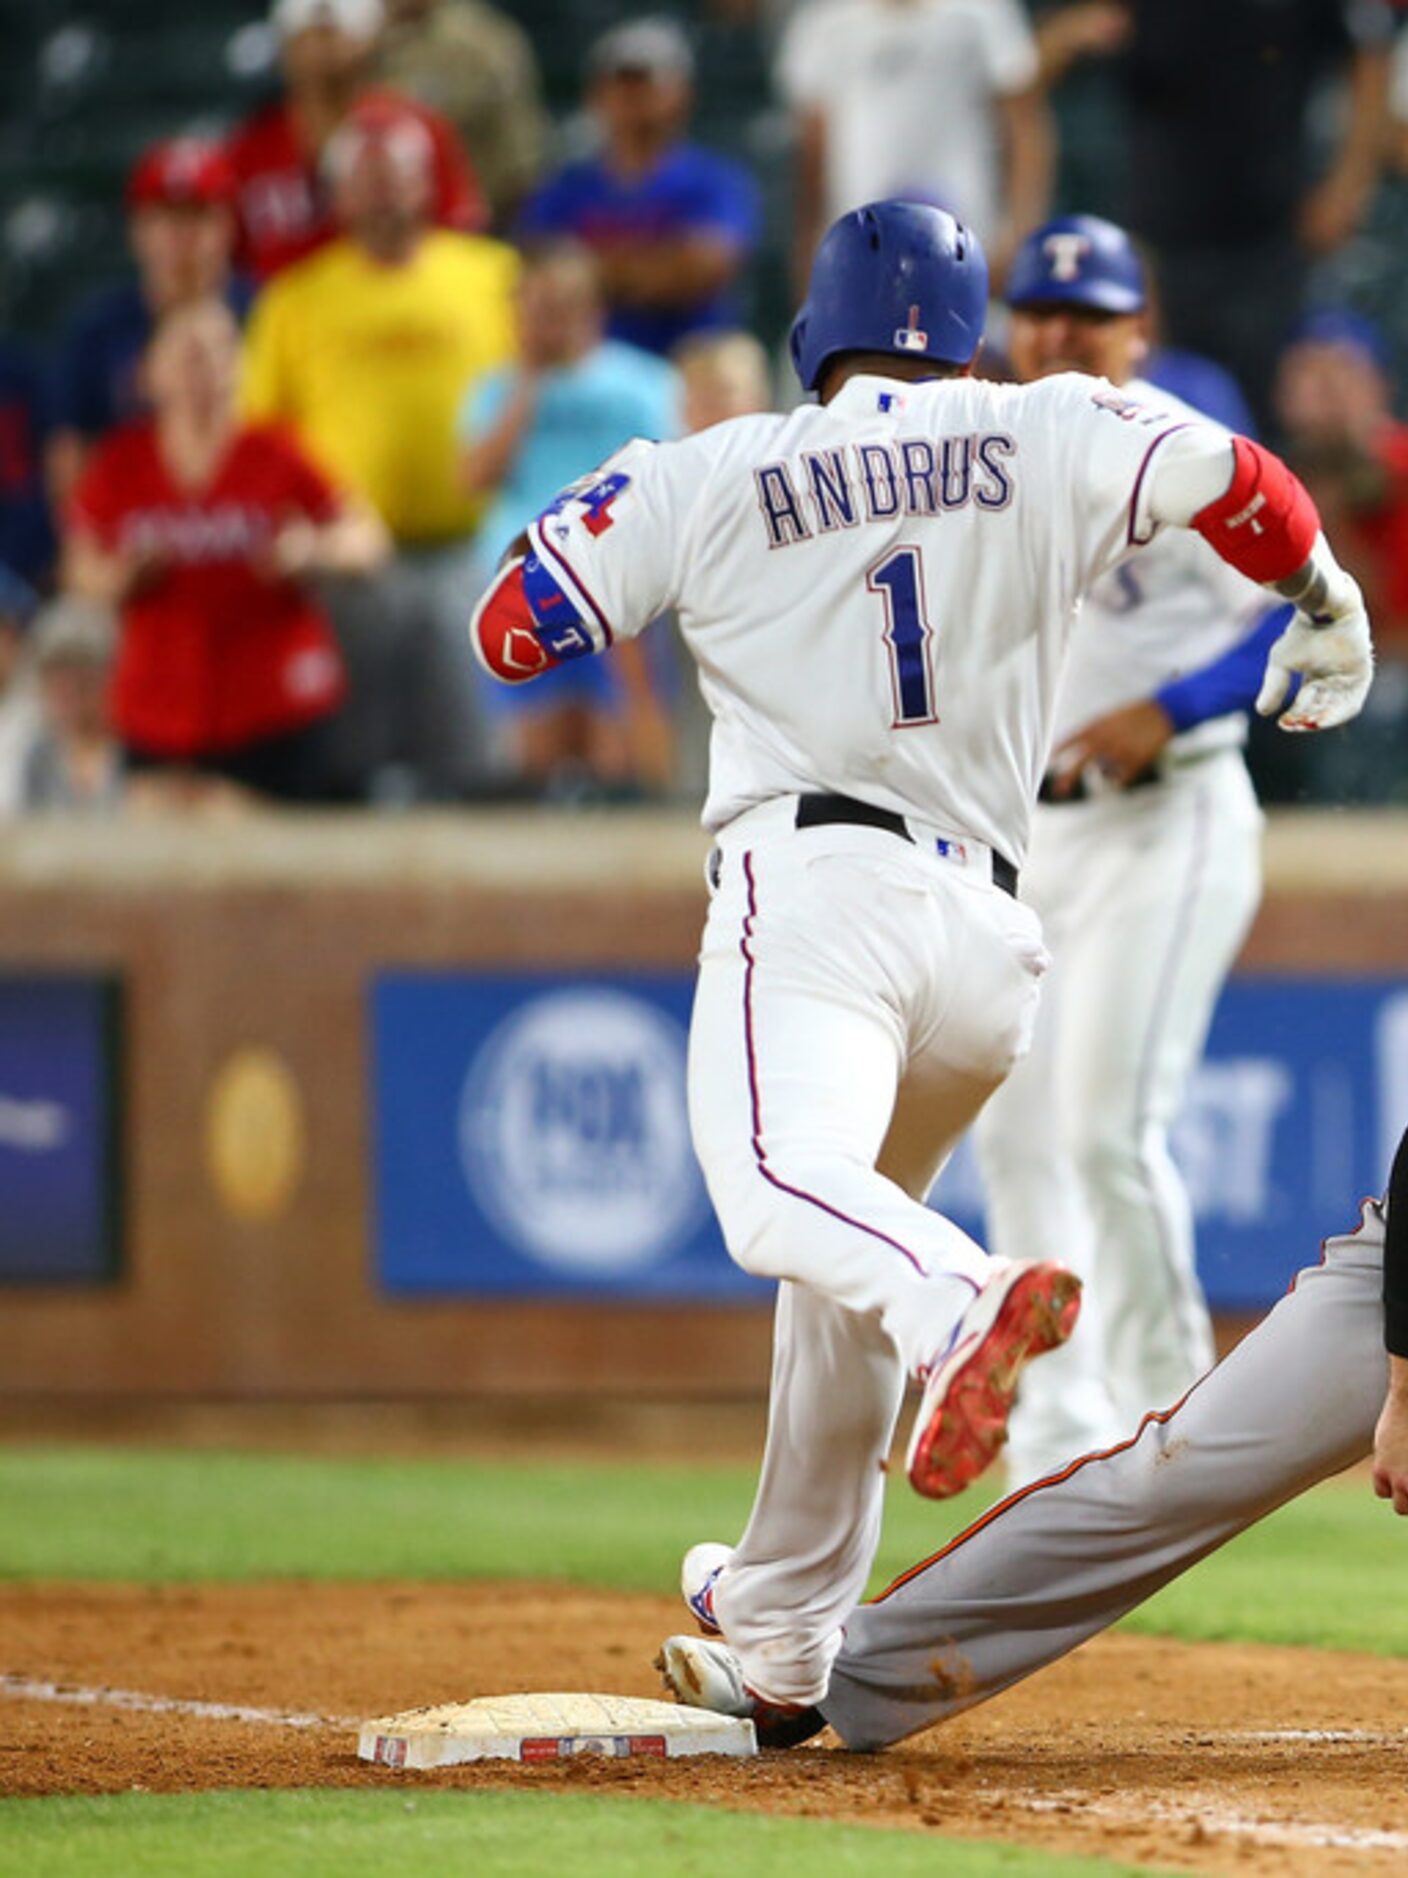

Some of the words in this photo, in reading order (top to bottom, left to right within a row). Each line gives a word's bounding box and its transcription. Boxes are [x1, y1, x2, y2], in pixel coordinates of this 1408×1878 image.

[1043, 233, 1092, 281] T
[754, 431, 1017, 550] ANDRUS
[552, 626, 585, 652] T
[865, 544, 940, 729] 1
